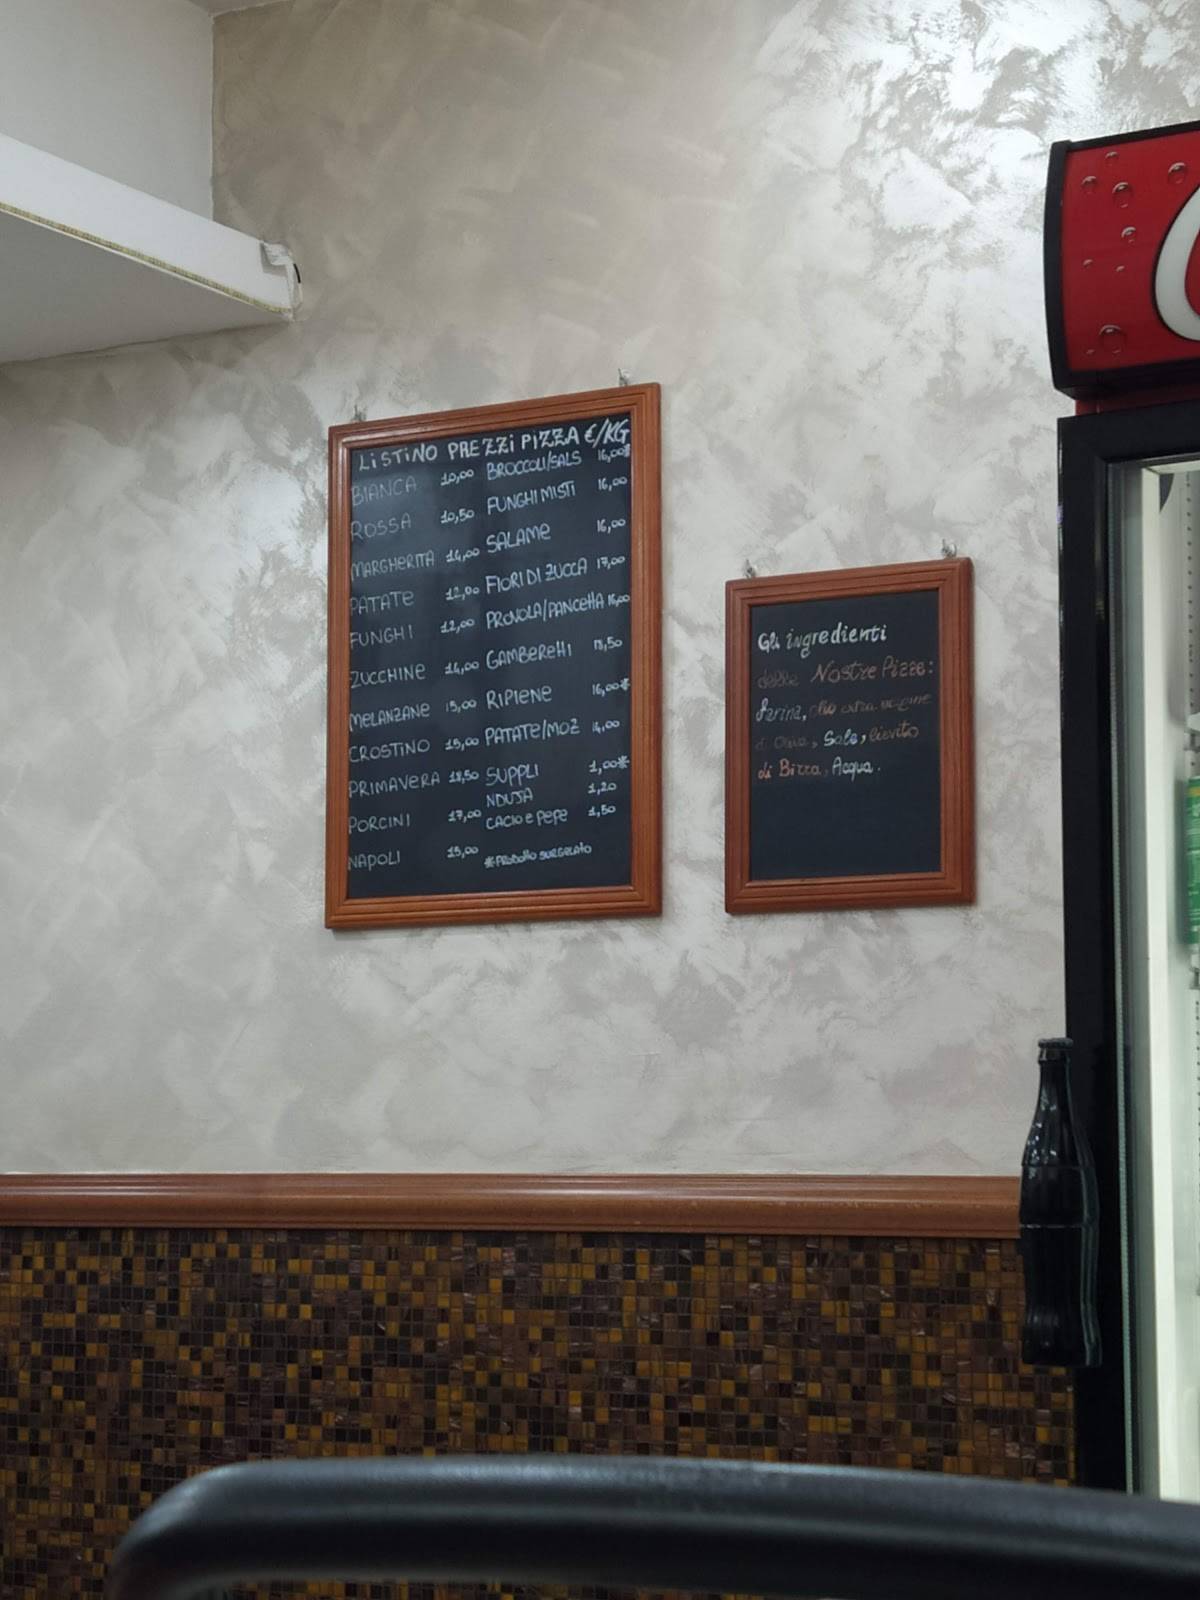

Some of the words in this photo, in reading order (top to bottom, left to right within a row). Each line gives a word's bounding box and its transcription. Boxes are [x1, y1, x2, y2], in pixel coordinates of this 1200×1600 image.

[351, 476, 417, 507] BIANCA
[440, 469, 475, 486] 10,00
[487, 489, 537, 515] FUNGHI
[597, 475, 628, 491] 16,00
[350, 513, 412, 542] ROSSA
[440, 508, 475, 525] 10,50
[597, 517, 626, 534] 16,00
[486, 569, 524, 595] FIORI
[527, 567, 541, 586] DI
[545, 557, 588, 581] ZUCCA
[349, 624, 414, 649] FUNGHI
[440, 618, 475, 635] 12,00
[786, 622, 888, 658] ingredienti
[811, 659, 878, 684] Nostre
[444, 737, 480, 752] 15,00
[757, 761, 773, 780] di
[587, 782, 617, 796] 1,20
[587, 804, 617, 818] 1,50
[348, 813, 411, 835] PORCINI
[348, 850, 401, 872] NAPOLI
[447, 846, 479, 859] 15,00
